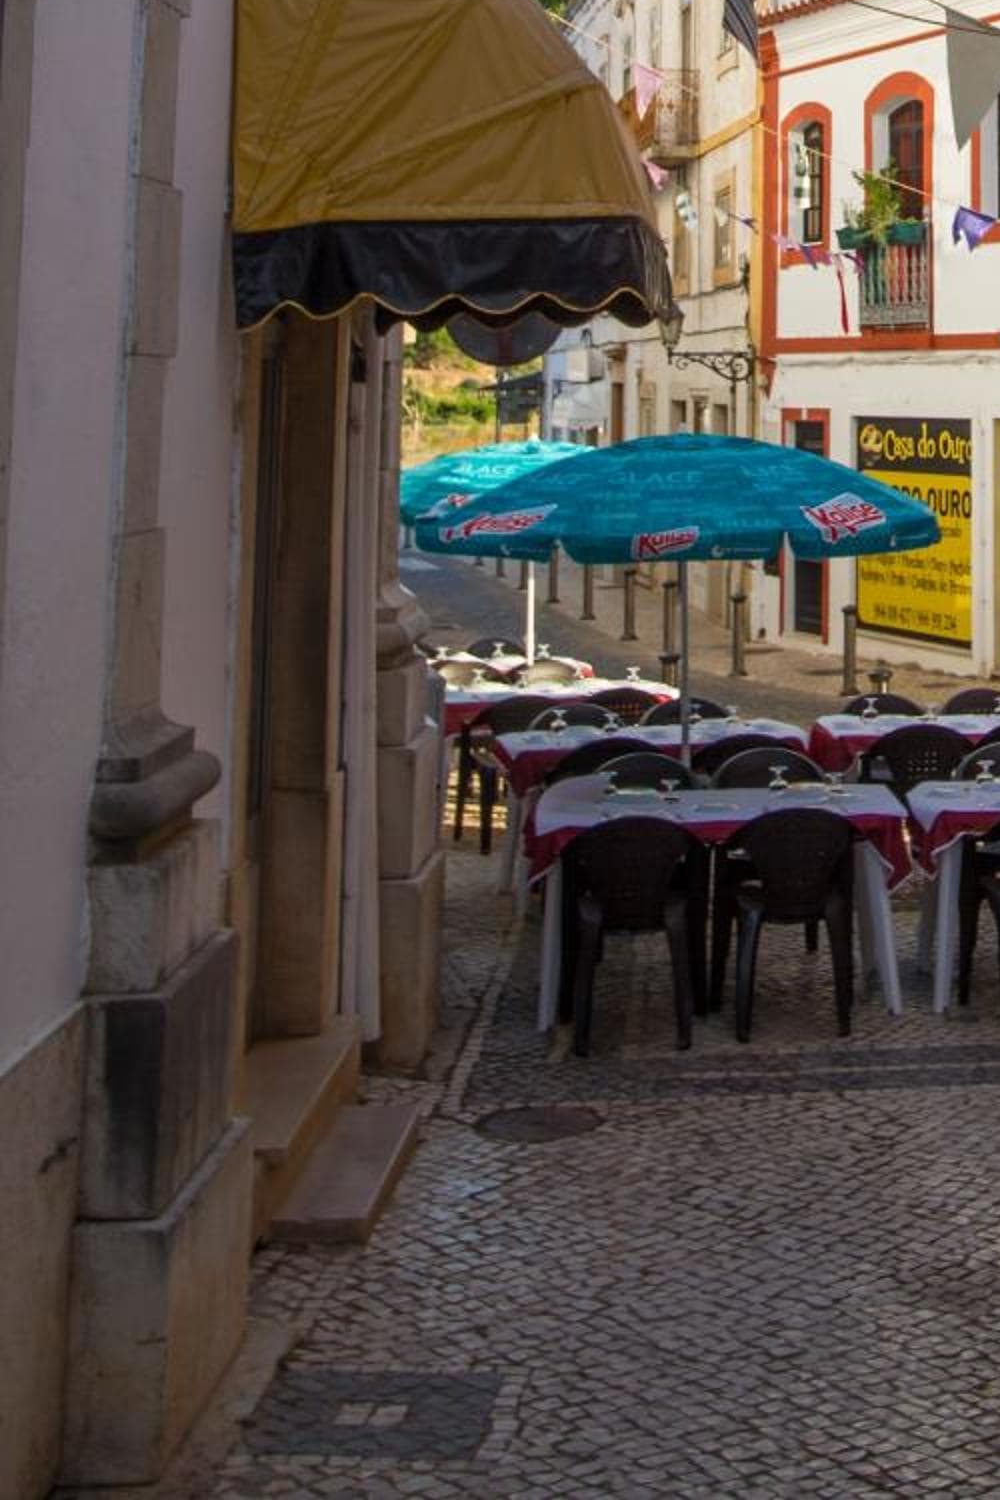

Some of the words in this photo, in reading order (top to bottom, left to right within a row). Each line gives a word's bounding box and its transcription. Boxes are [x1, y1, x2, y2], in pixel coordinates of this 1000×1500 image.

[884, 429, 914, 461] Casa
[918, 421, 936, 458] do
[940, 430, 971, 464] Ouro
[805, 505, 883, 541] Kalise
